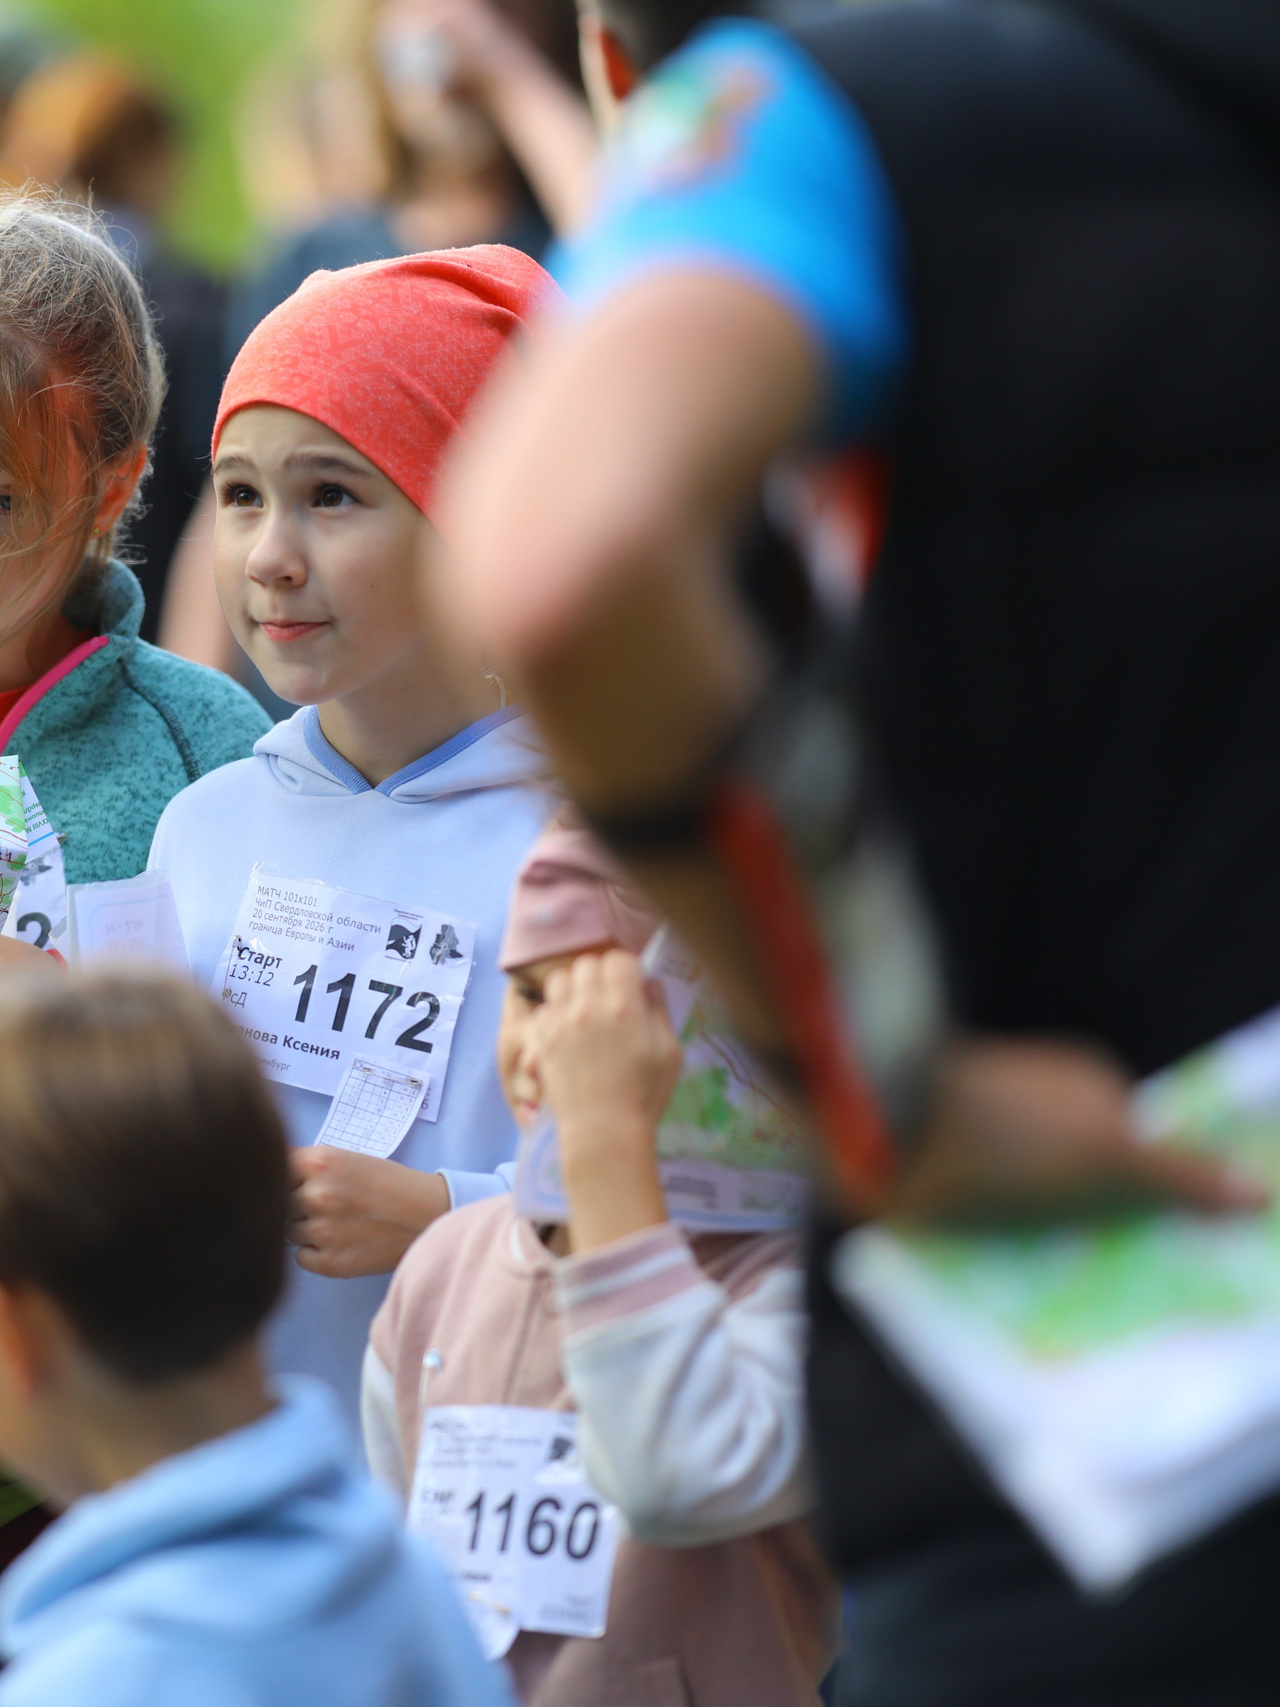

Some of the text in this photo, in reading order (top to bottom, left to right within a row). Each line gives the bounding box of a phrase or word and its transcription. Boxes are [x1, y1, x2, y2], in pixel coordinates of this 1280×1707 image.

[257, 885, 281, 899] МАТЧ
[252, 908, 263, 919] 20
[264, 911, 303, 928] сентября
[304, 919, 325, 933] 2026
[255, 897, 382, 934] ЧиП Свердловской области
[249, 920, 283, 935] граница
[285, 928, 316, 943] Европы
[326, 937, 356, 952] Азии
[237, 946, 283, 970] Старт
[229, 963, 275, 987] 13:12
[292, 963, 441, 1054] 1172
[234, 1024, 340, 1061] анова Ксения
[464, 1490, 600, 1561] 1160
